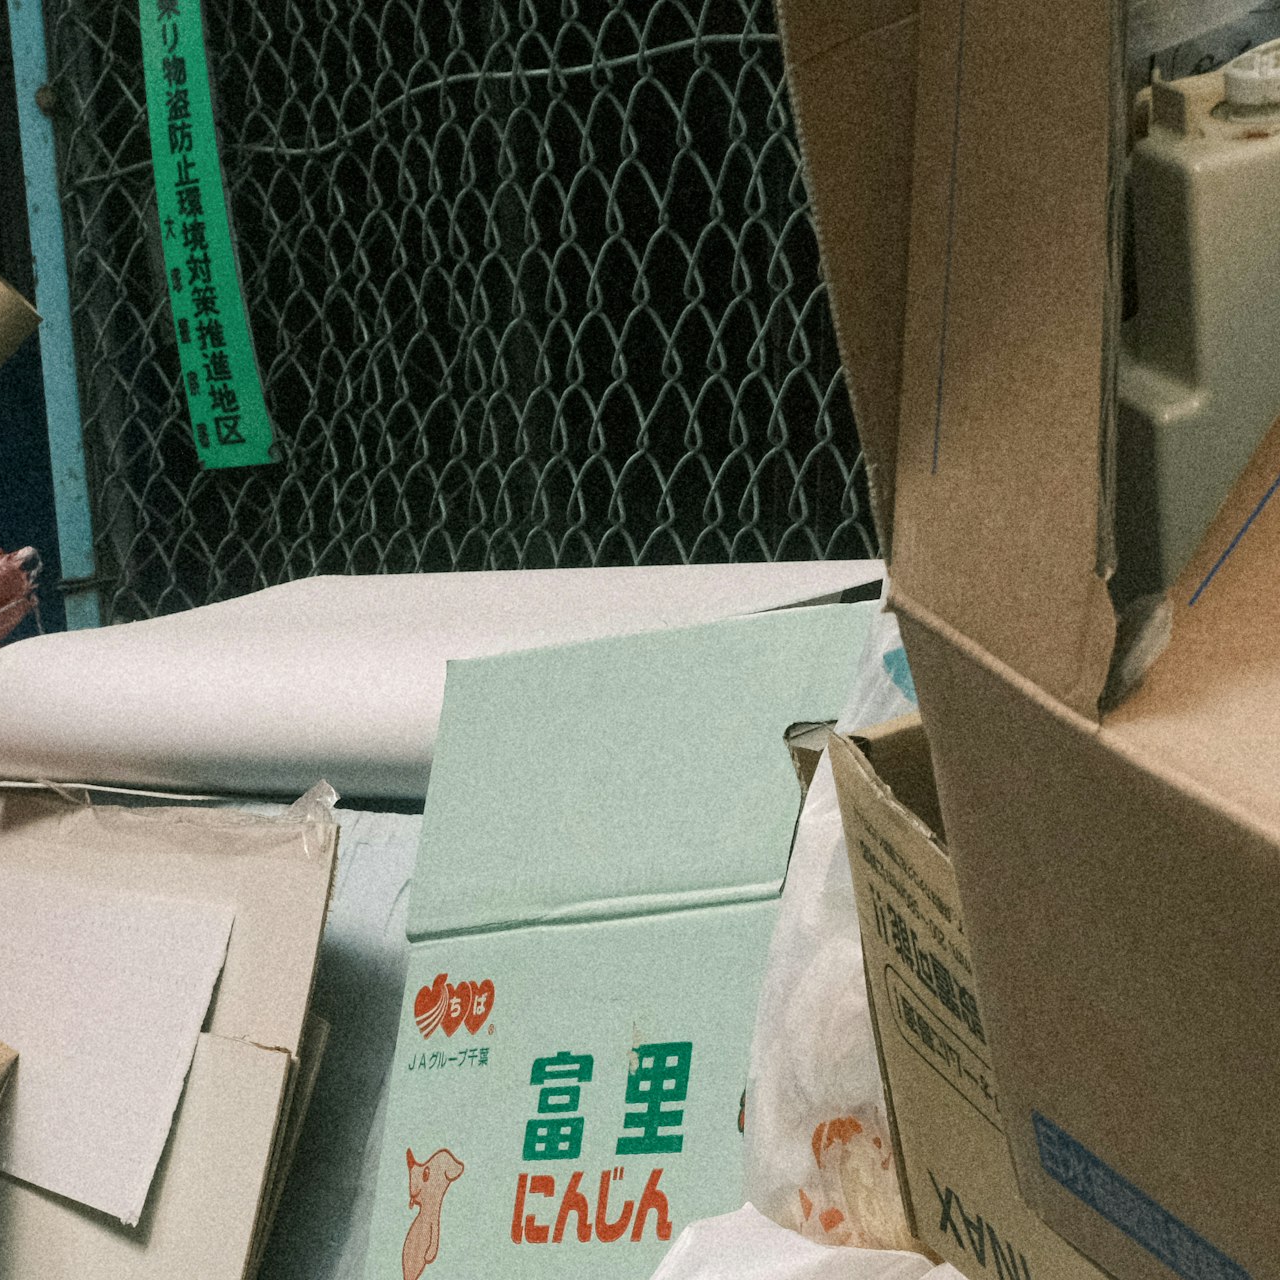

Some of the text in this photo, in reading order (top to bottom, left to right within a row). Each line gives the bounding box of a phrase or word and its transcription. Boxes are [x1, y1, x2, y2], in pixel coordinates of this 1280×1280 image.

[521, 1040, 693, 1162] 富里
[510, 1166, 673, 1245] にんじん
